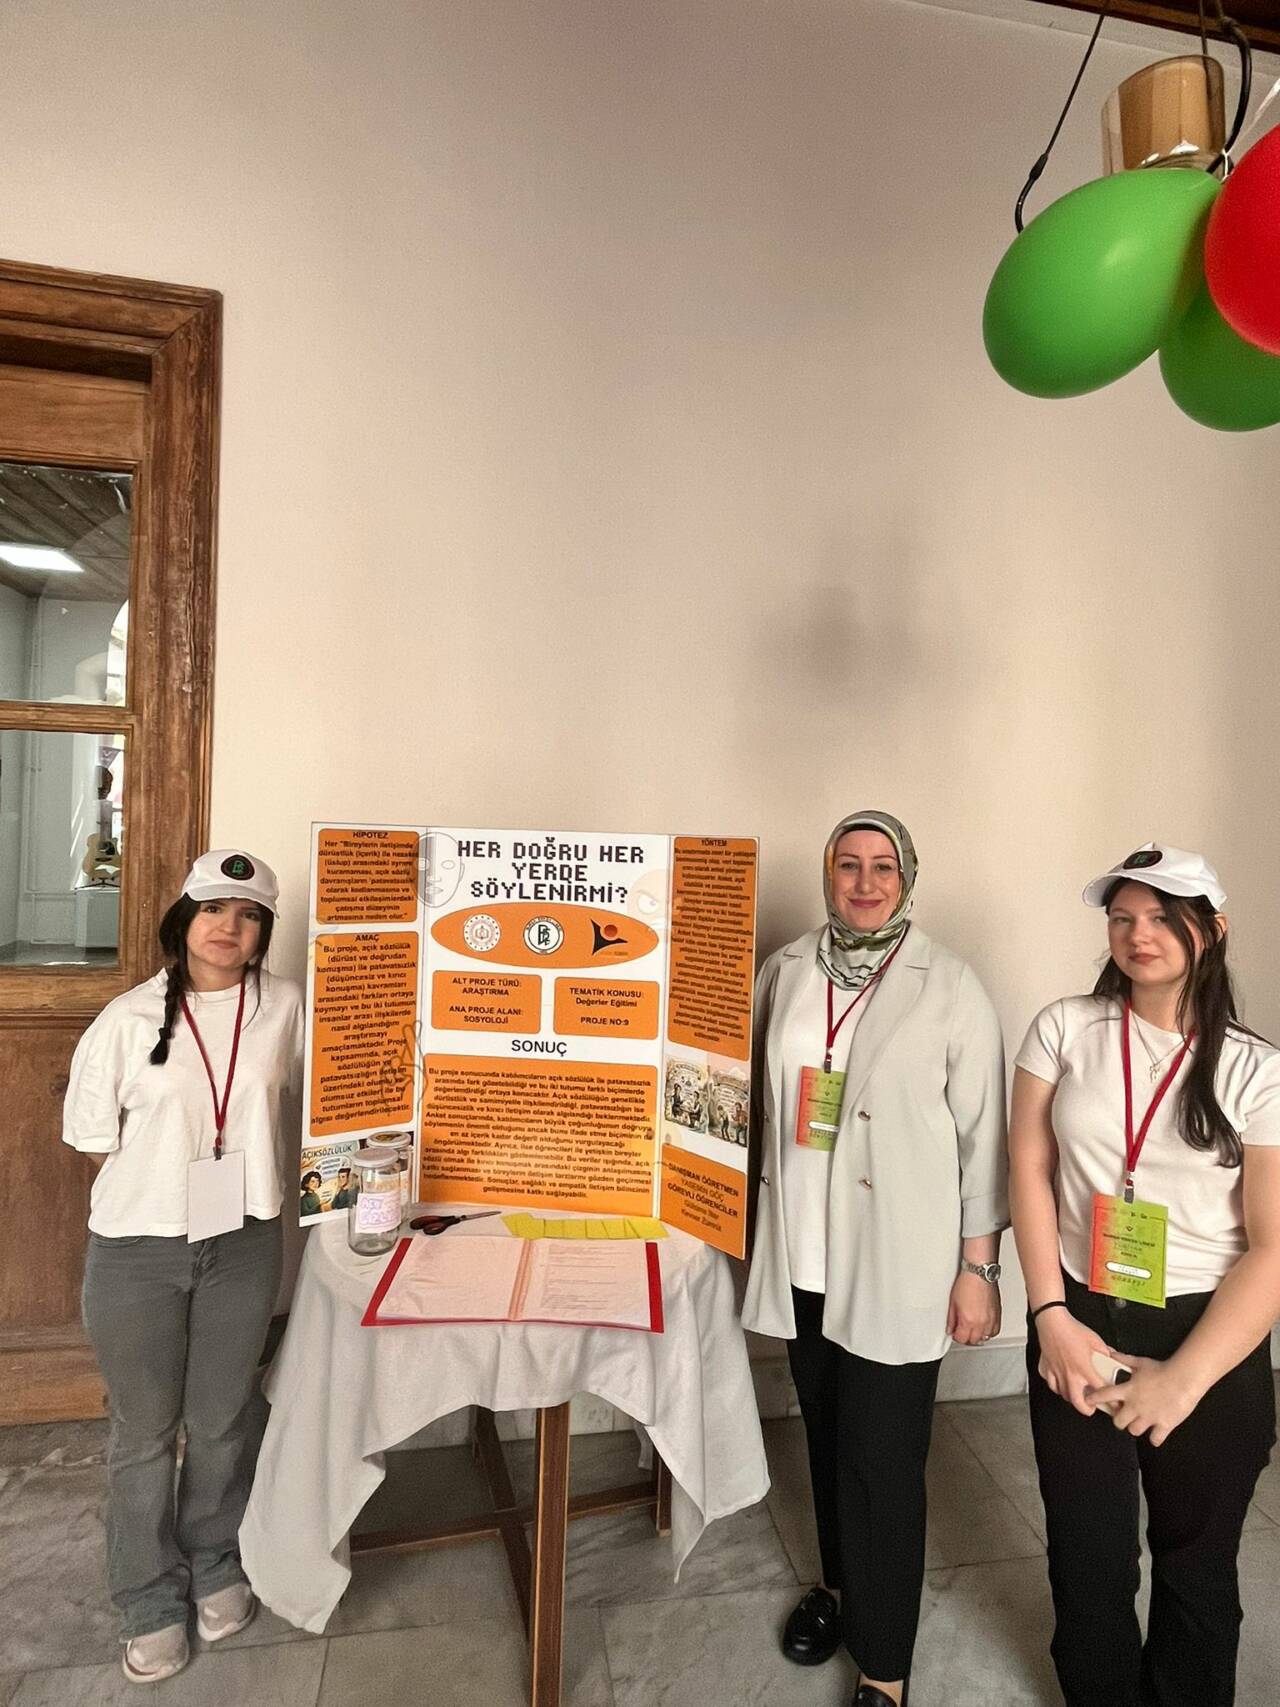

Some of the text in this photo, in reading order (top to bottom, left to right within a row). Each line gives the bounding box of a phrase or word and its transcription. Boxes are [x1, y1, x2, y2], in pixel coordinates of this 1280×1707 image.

[458, 837, 644, 863] HER DOĞRU HER
[512, 863, 587, 882] YERDE
[471, 878, 628, 903] SÖYLENİRMİ?
[370, 953, 406, 961] doğrudan
[469, 978, 495, 986] PROJE
[498, 978, 522, 987] TÜRÜ:
[463, 987, 509, 996] ARAŞTIRMA
[570, 987, 644, 998] TEMATİK KONUSU:
[576, 998, 637, 1008] Değerler Eğitimi
[464, 1016, 508, 1024] SOSYOLOJİ
[581, 1017, 607, 1025] PROJE
[511, 1040, 567, 1056] SONUÇ
